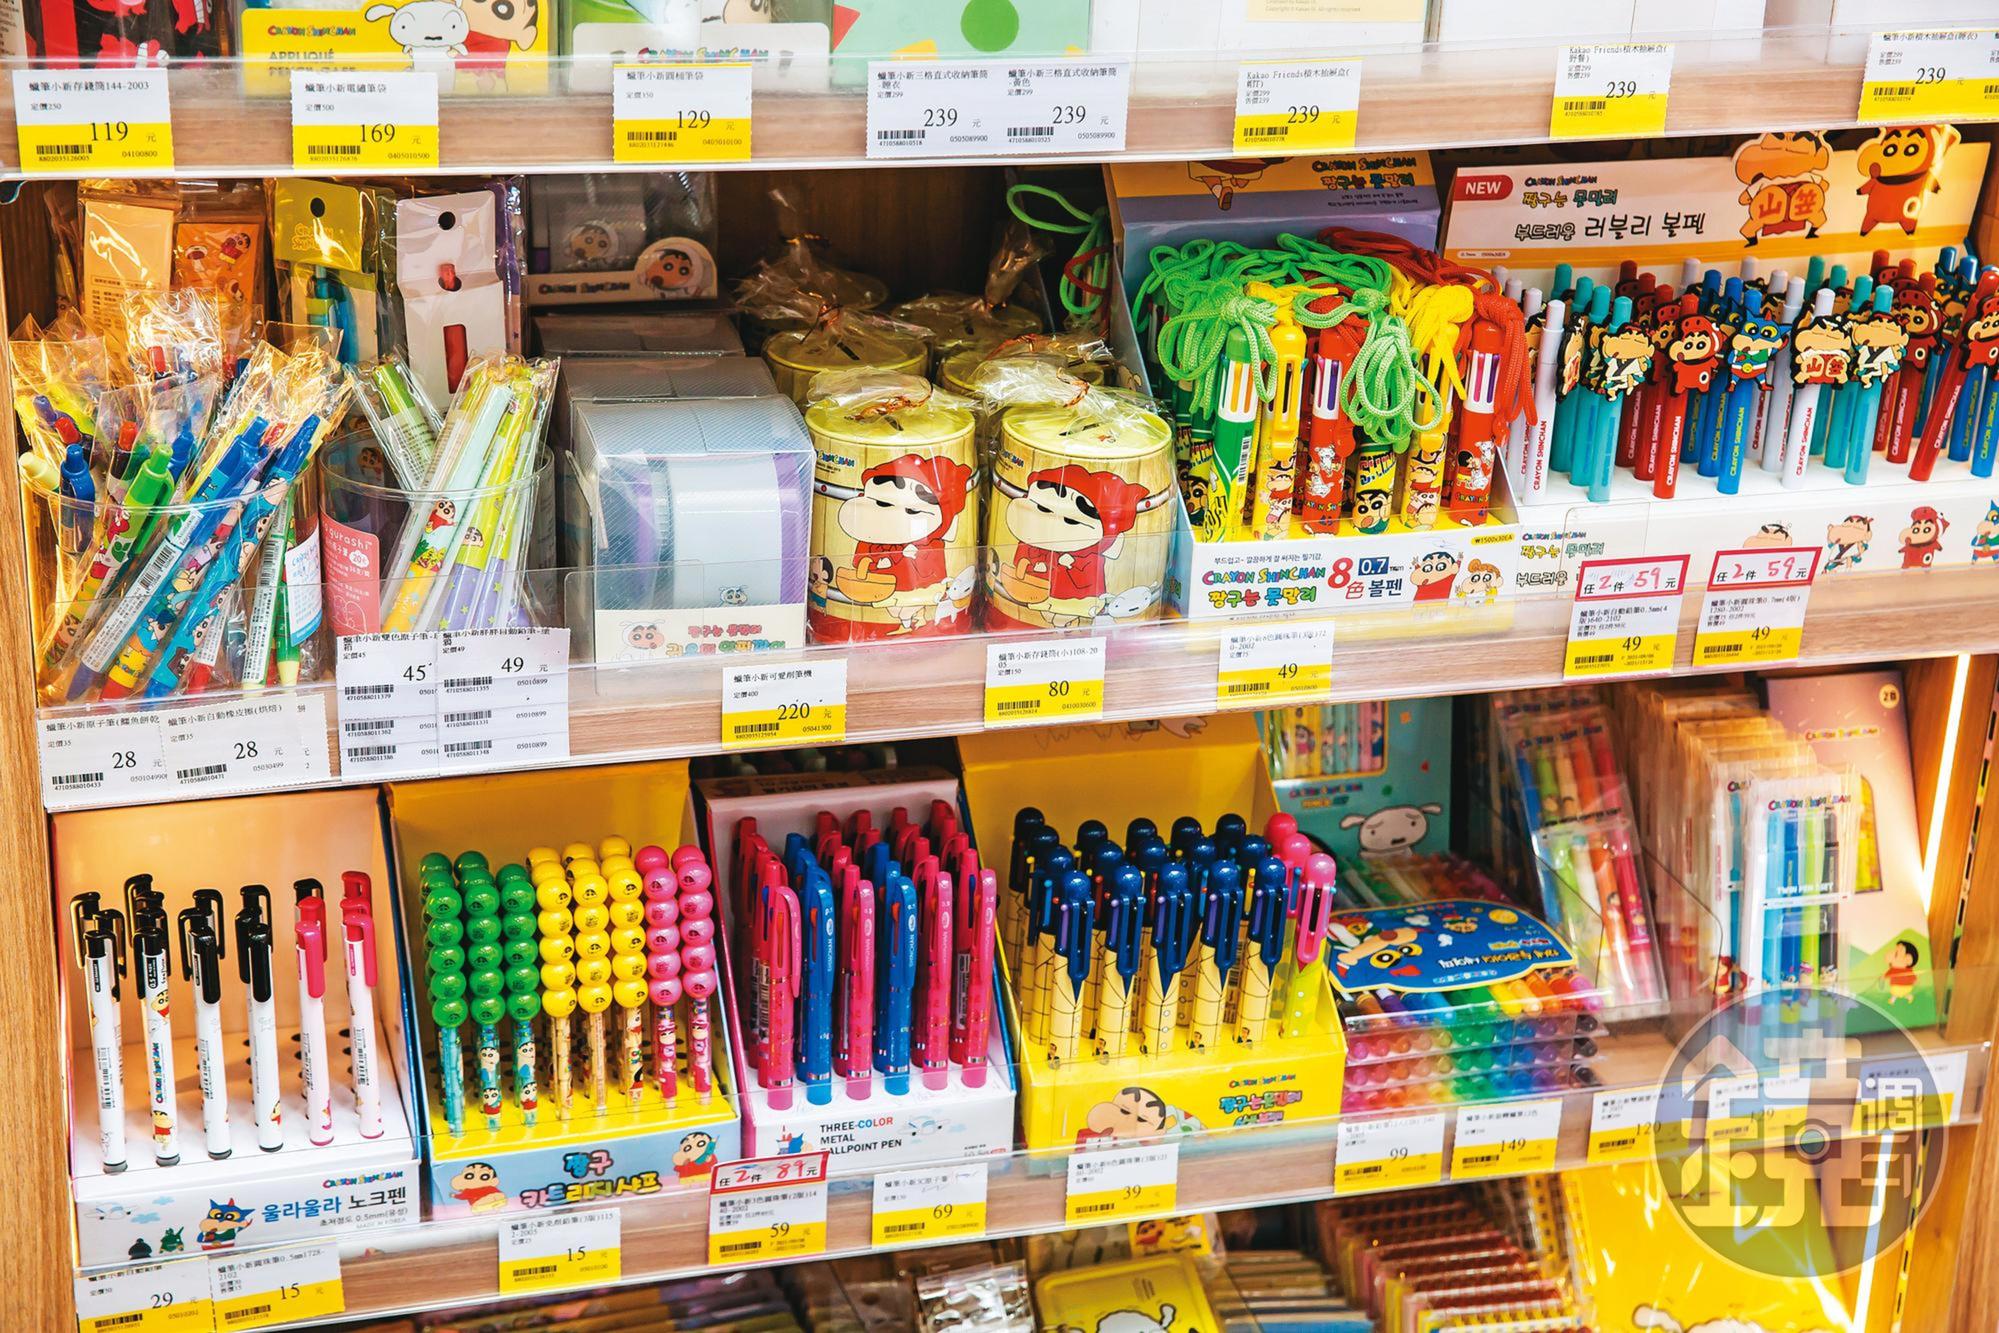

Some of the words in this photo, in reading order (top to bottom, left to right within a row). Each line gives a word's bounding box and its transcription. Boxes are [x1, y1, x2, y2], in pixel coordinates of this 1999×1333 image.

[1247, 71, 1270, 79] Kakao
[1915, 67, 1946, 84] 239
[1605, 81, 1637, 98] 239
[1648, 91, 1656, 99] 元
[677, 110, 711, 129] 129
[726, 122, 735, 131] 元
[924, 108, 958, 127] 239
[972, 119, 981, 128] 元
[1053, 105, 1086, 124] 239
[1100, 116, 1109, 125] 元
[1288, 105, 1320, 124] 239
[1332, 115, 1340, 124] 元
[91, 121, 128, 141] 119
[147, 134, 156, 142] 元
[361, 124, 395, 143] 169
[412, 136, 421, 144] 元
[1465, 181, 1502, 195] NEW
[1522, 191, 1568, 208] 짱구는
[1514, 222, 1576, 241] 부드러운
[1585, 215, 1652, 239] 러블리
[1661, 212, 1706, 238] 볼펜
[1536, 420, 1547, 458] SHINCHAN
[1666, 454, 1676, 486] CRAYON
[1671, 416, 1682, 453] SHINCHAN
[1533, 458, 1543, 490] CRAYON
[1202, 571, 1255, 586] CRAYON
[1258, 567, 1326, 583] SHINCHAN
[1516, 570, 1568, 587] 부드러운
[1369, 578, 1402, 597] 볼펜
[1208, 589, 1260, 609] 짱구는
[1264, 586, 1317, 606] 못말려
[1751, 627, 1771, 642] 49
[1622, 636, 1642, 651] 49
[402, 664, 427, 681] 45
[501, 656, 525, 673] 49
[538, 664, 548, 672] 元
[1278, 662, 1298, 680] 49
[516, 678, 548, 686] 05010899
[1048, 680, 1070, 697] 80
[1083, 688, 1090, 696] 元
[516, 711, 547, 719] 05010899
[777, 702, 810, 721] 220
[824, 709, 832, 718] 元
[48, 740, 72, 748] 定價35
[170, 733, 194, 742] 定價35
[233, 741, 259, 760] 28
[273, 746, 283, 756] 元
[112, 751, 137, 769] 28
[153, 758, 162, 767] 元
[820, 1117, 894, 1133] THREE-COLOR
[820, 1133, 855, 1145] METAL
[821, 1142, 878, 1156] ALLPOINT
[881, 1138, 902, 1149] PEN
[1500, 1138, 1526, 1153] 149
[1390, 1148, 1409, 1162] 99
[563, 1150, 614, 1179] 짱구
[322, 1178, 357, 1188] CRAYON
[1123, 1184, 1142, 1200] 39
[261, 1196, 342, 1223] 울라울라
[348, 1186, 406, 1209] 노크펜
[933, 1203, 953, 1219] 69
[769, 1222, 790, 1238] 59
[567, 1246, 586, 1262] 15
[280, 1282, 300, 1300] 15
[150, 1292, 174, 1309] 29
